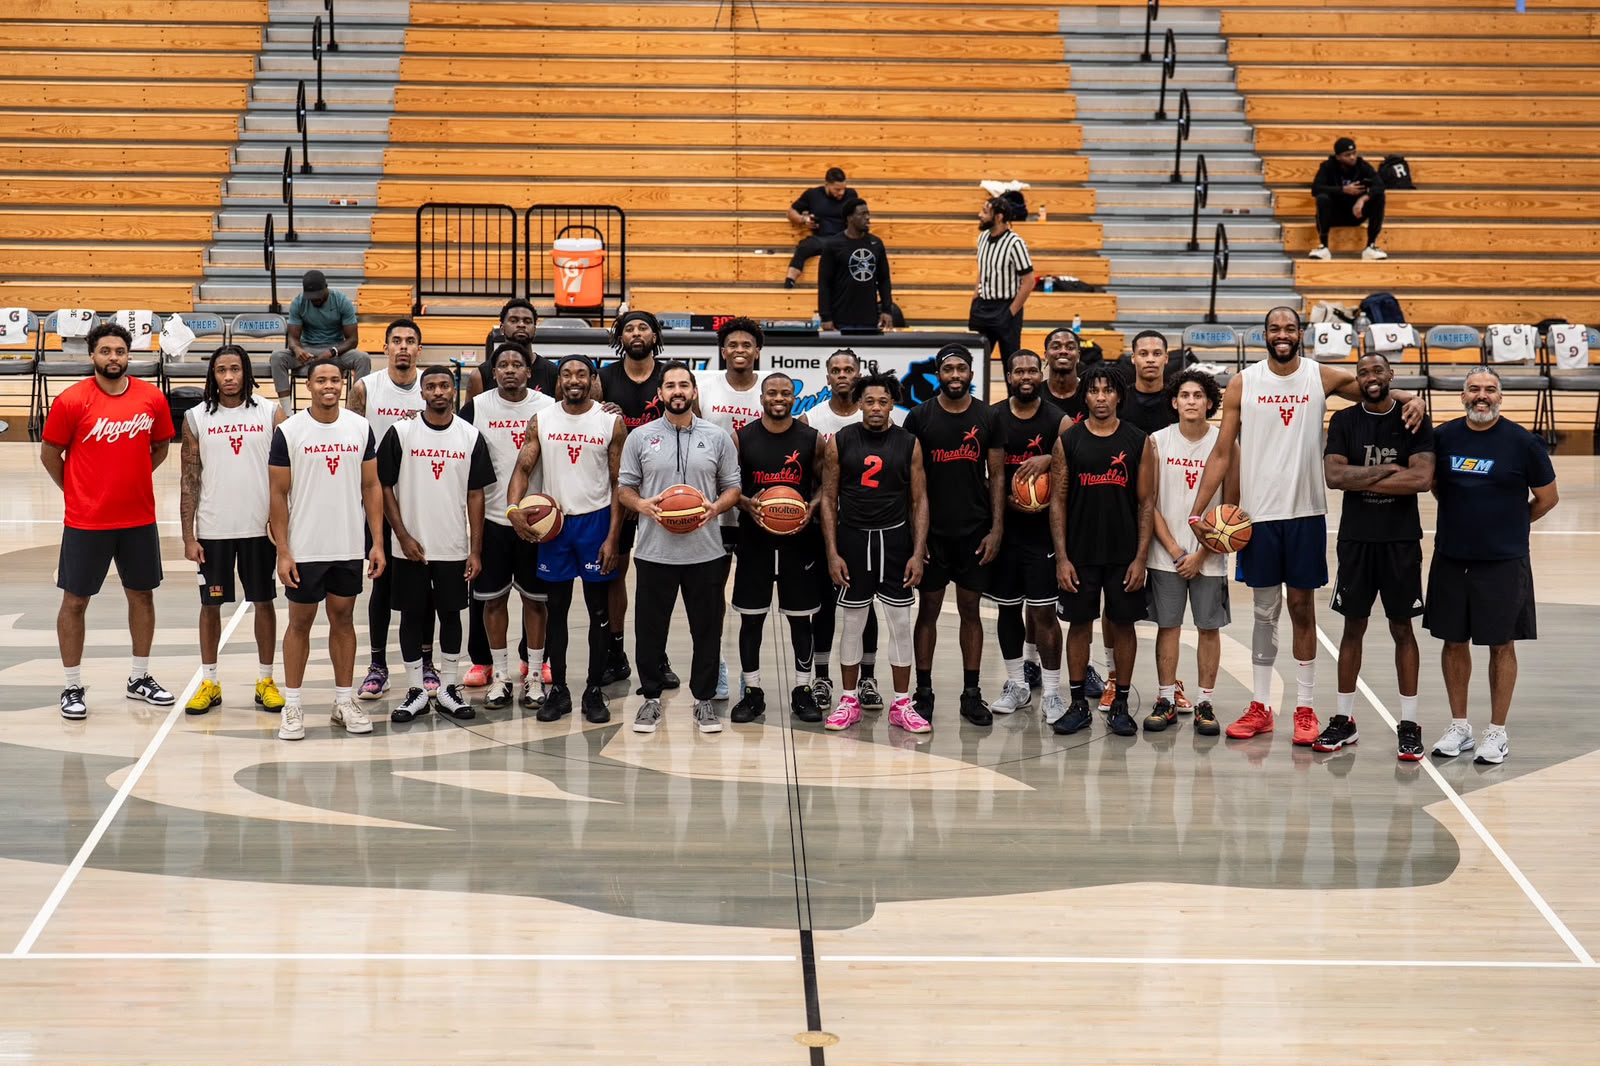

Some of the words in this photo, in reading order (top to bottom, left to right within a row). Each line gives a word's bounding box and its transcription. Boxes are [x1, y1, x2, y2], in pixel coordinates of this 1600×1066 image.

[1393, 163, 1407, 178] R
[185, 320, 217, 329] NTHERS
[239, 320, 280, 330] PANTHERS
[1191, 331, 1233, 341] PANTHERS
[1433, 332, 1475, 343] PANTHERS
[771, 356, 820, 369] Home
[858, 356, 878, 369] he
[488, 420, 529, 429] MAZAT
[1167, 457, 1206, 468] MAZATL
[861, 455, 883, 488] 2
[768, 505, 800, 515] molten
